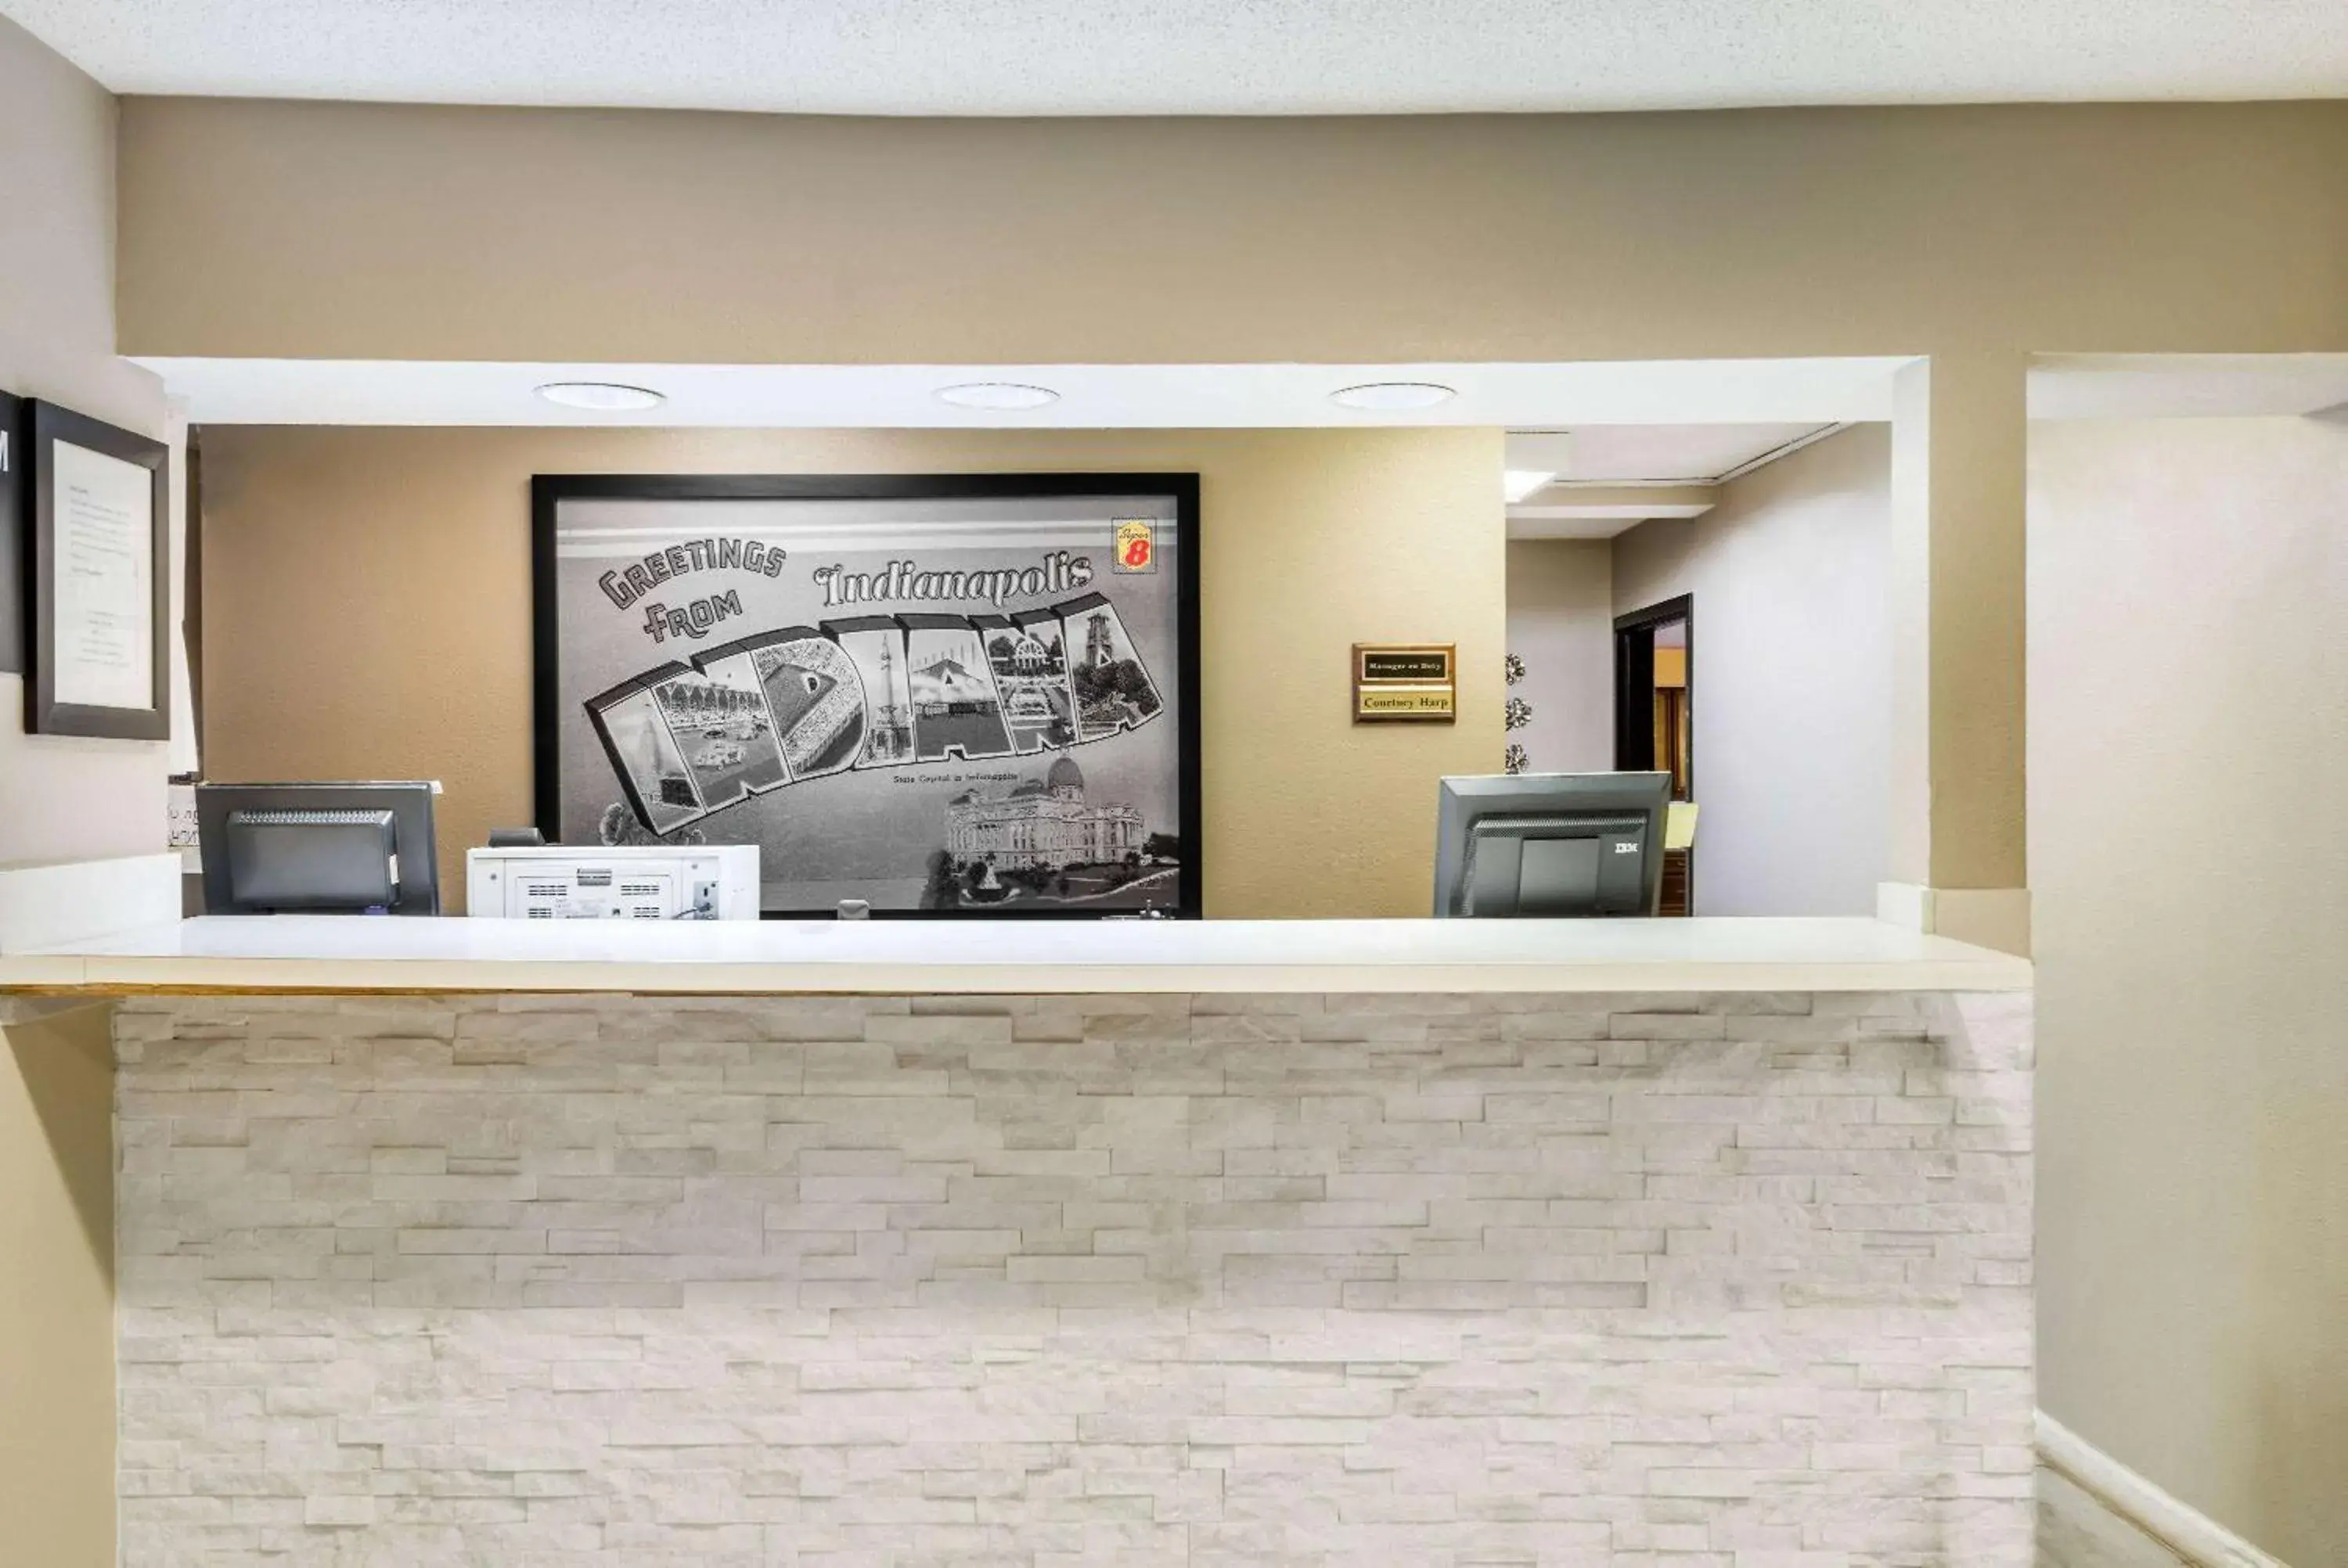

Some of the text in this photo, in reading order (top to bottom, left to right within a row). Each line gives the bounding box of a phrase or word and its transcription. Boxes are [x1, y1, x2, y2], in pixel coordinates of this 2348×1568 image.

[599, 538, 787, 611] GREETINGS
[813, 550, 1093, 607] Indianapolis
[1125, 540, 1150, 566] 8
[643, 589, 743, 643] FROM
[585, 592, 1164, 836] INDIANA
[1364, 697, 1448, 709] Courtney Harp
[1615, 843, 1638, 853] IBM
